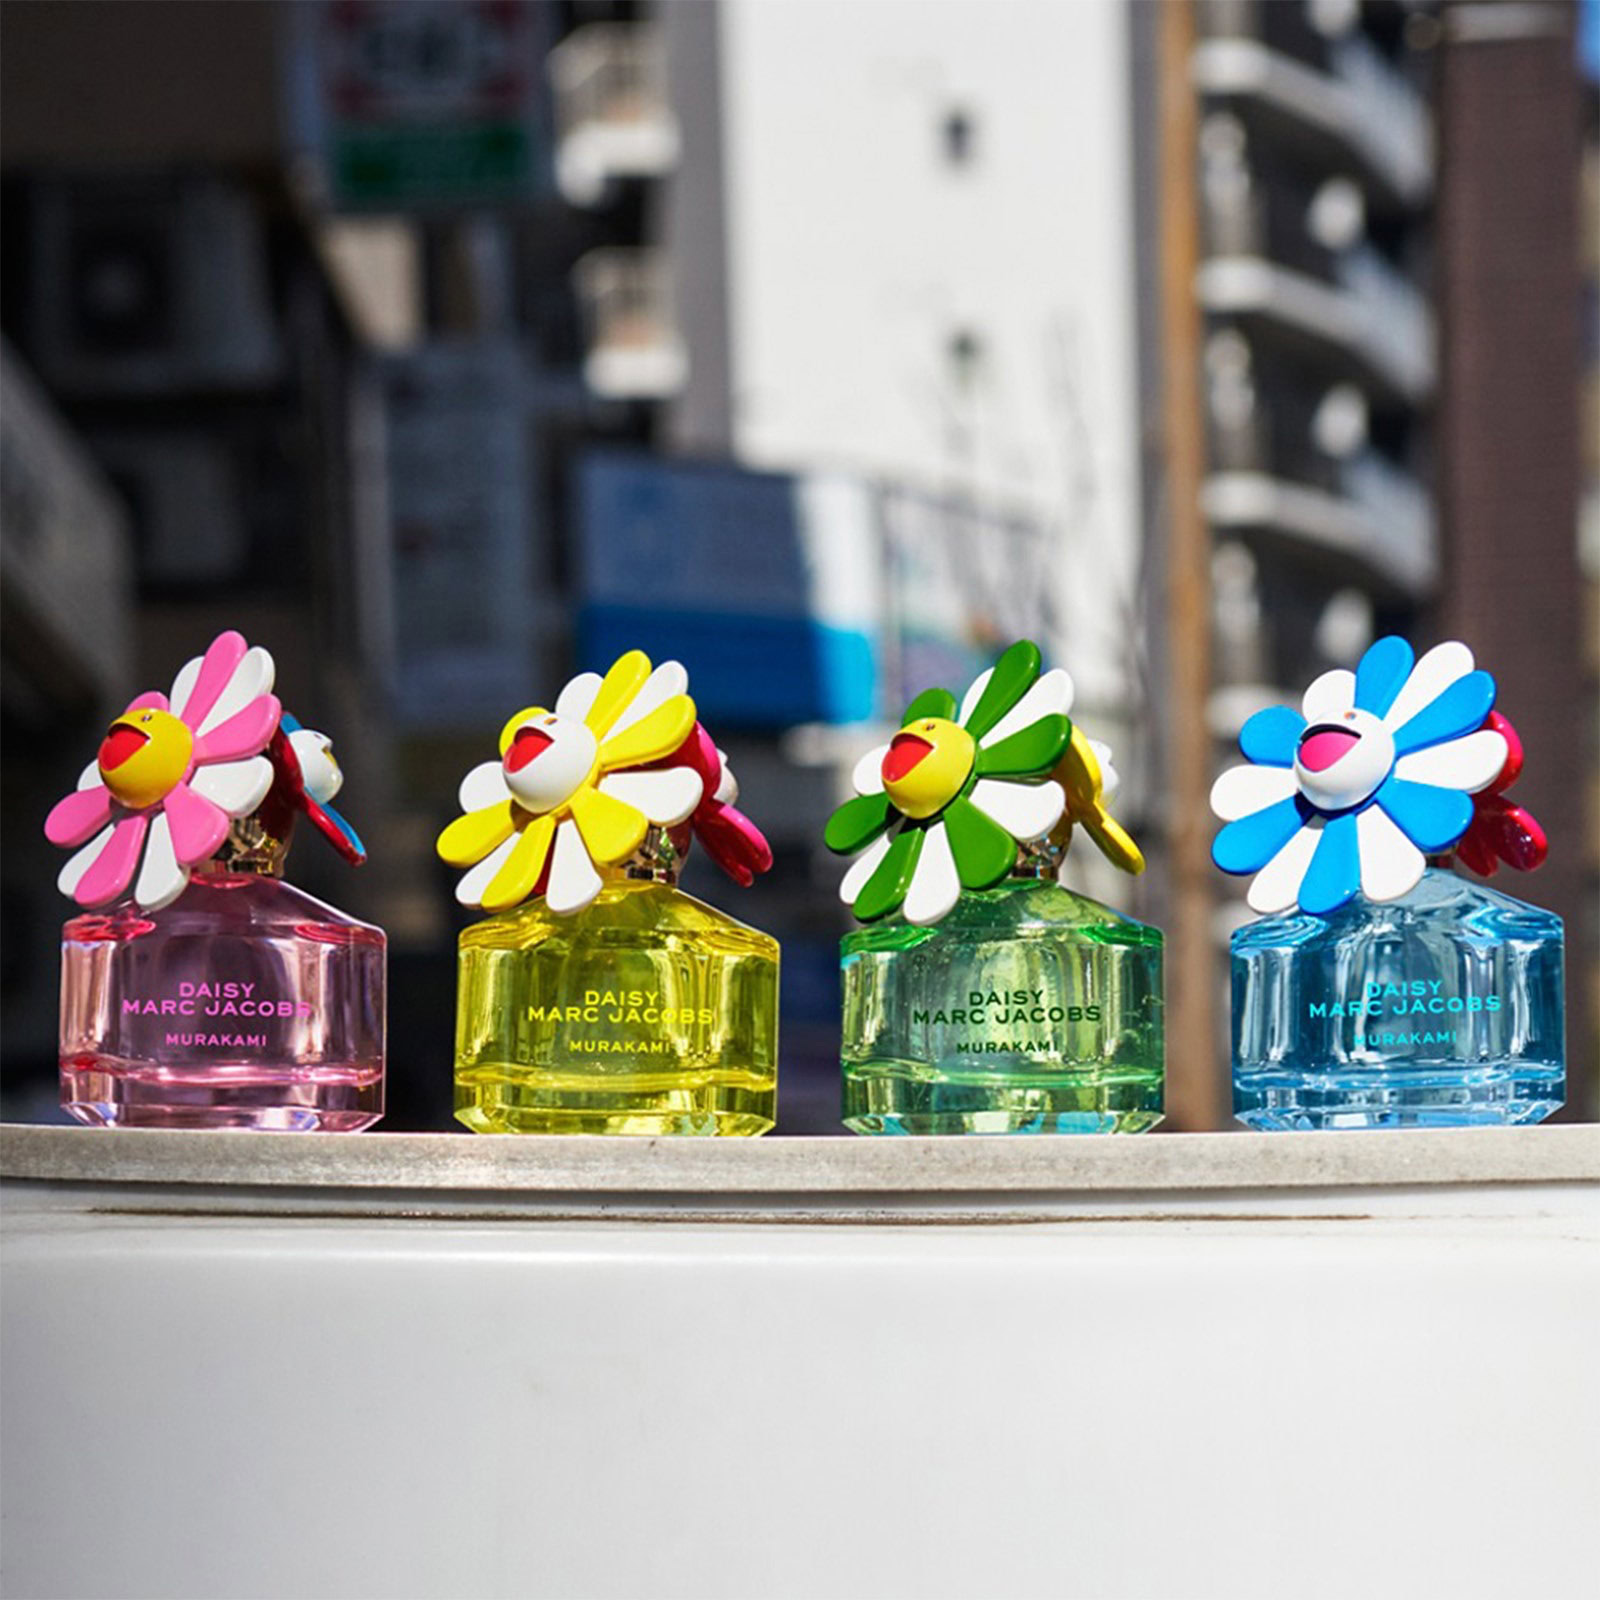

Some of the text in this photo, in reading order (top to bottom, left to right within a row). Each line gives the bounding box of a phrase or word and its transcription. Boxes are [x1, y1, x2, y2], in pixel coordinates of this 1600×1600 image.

[179, 982, 255, 998] DAISY
[1367, 980, 1442, 998] DAISY
[585, 990, 659, 1006] DAISY
[969, 990, 1044, 1006] DAISY
[122, 999, 312, 1017] MARC JACOBS
[1309, 995, 1501, 1018] MARC JACOBS
[528, 1006, 713, 1024] MARC JACOBS
[914, 1006, 1101, 1025] MARC JACOBS
[165, 1033, 267, 1047] MURAKAMI
[569, 1040, 670, 1053] MURAKAMI
[1354, 1031, 1456, 1046] MURAKAMI
[957, 1041, 1058, 1054] MURAKAMI
